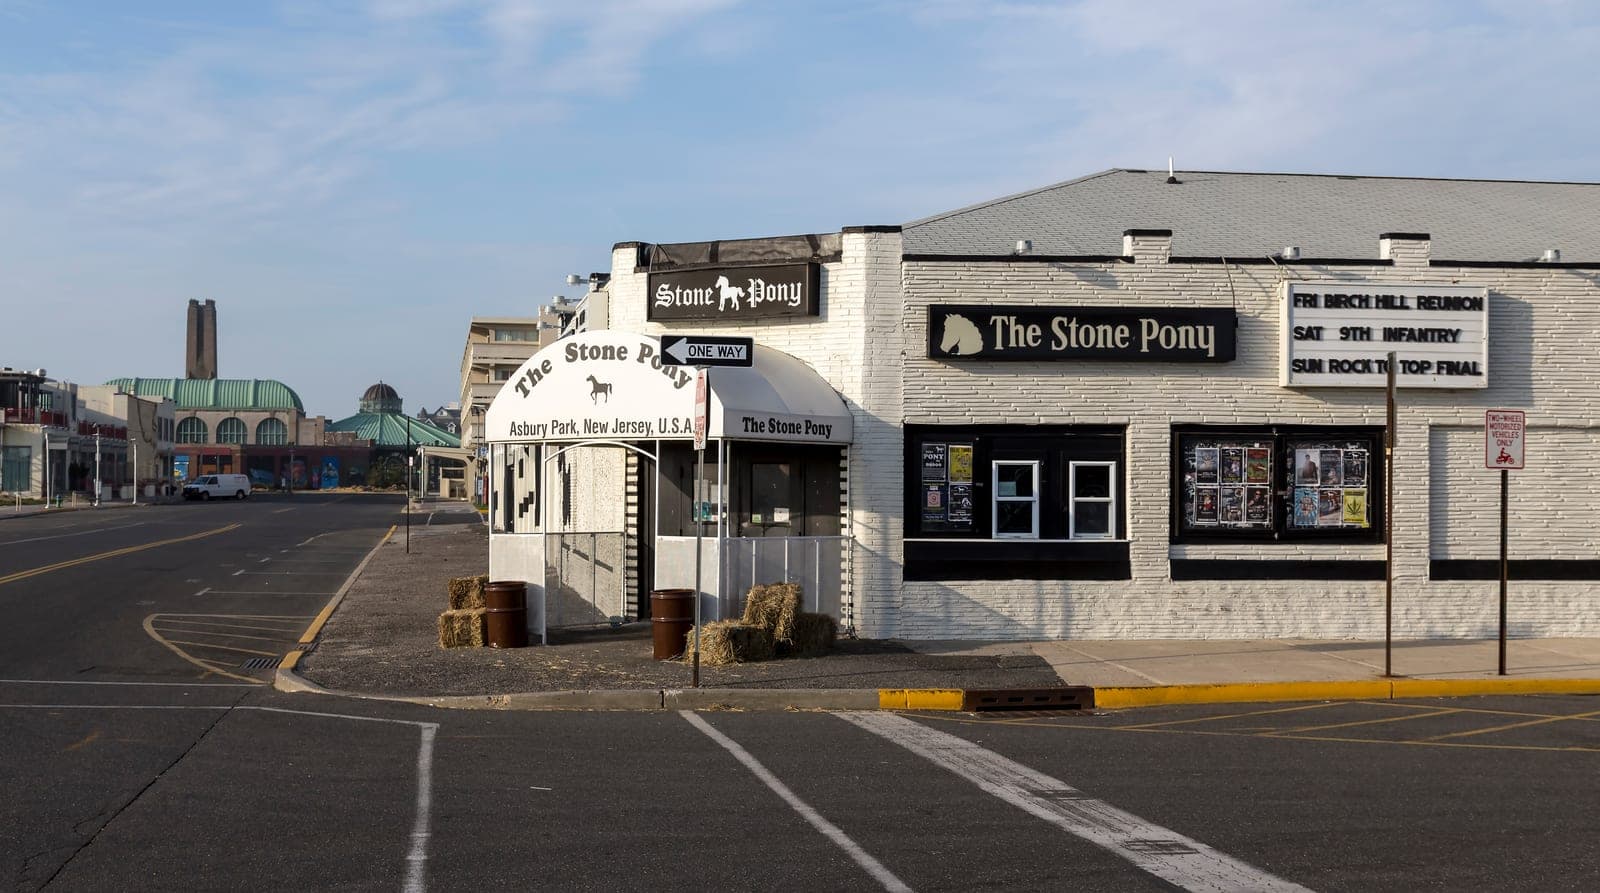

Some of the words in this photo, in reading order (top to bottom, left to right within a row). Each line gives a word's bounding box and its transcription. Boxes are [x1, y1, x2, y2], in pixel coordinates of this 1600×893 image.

[655, 283, 714, 307] Stone
[747, 278, 802, 307] Pony
[1293, 293, 1317, 308] FRI
[1324, 294, 1369, 309] BIRCH
[1375, 294, 1409, 310] HILL
[1417, 295, 1483, 311] REUNION
[990, 315, 1042, 350] The
[1052, 316, 1129, 351] Stone
[1139, 318, 1215, 357] Pony
[1294, 326, 1323, 341] SAT
[1339, 326, 1370, 341] 9TH
[1383, 327, 1460, 342] INFANTRY
[688, 345, 712, 357] ONE
[718, 345, 743, 358] WAY
[515, 359, 552, 398] The
[565, 342, 628, 363] Stone
[1292, 359, 1322, 373] SUN
[1329, 359, 1371, 374] ROCK
[1399, 360, 1431, 375] TOP
[1437, 361, 1482, 376] FINAL
[510, 420, 547, 438] Asbury
[551, 419, 579, 436] Park,
[584, 418, 608, 434] New
[612, 417, 653, 437] Jersey,
[742, 417, 765, 433] The
[768, 418, 802, 434] Stone
[804, 419, 832, 439] Pony
[1489, 422, 1521, 430] MOTORIZED
